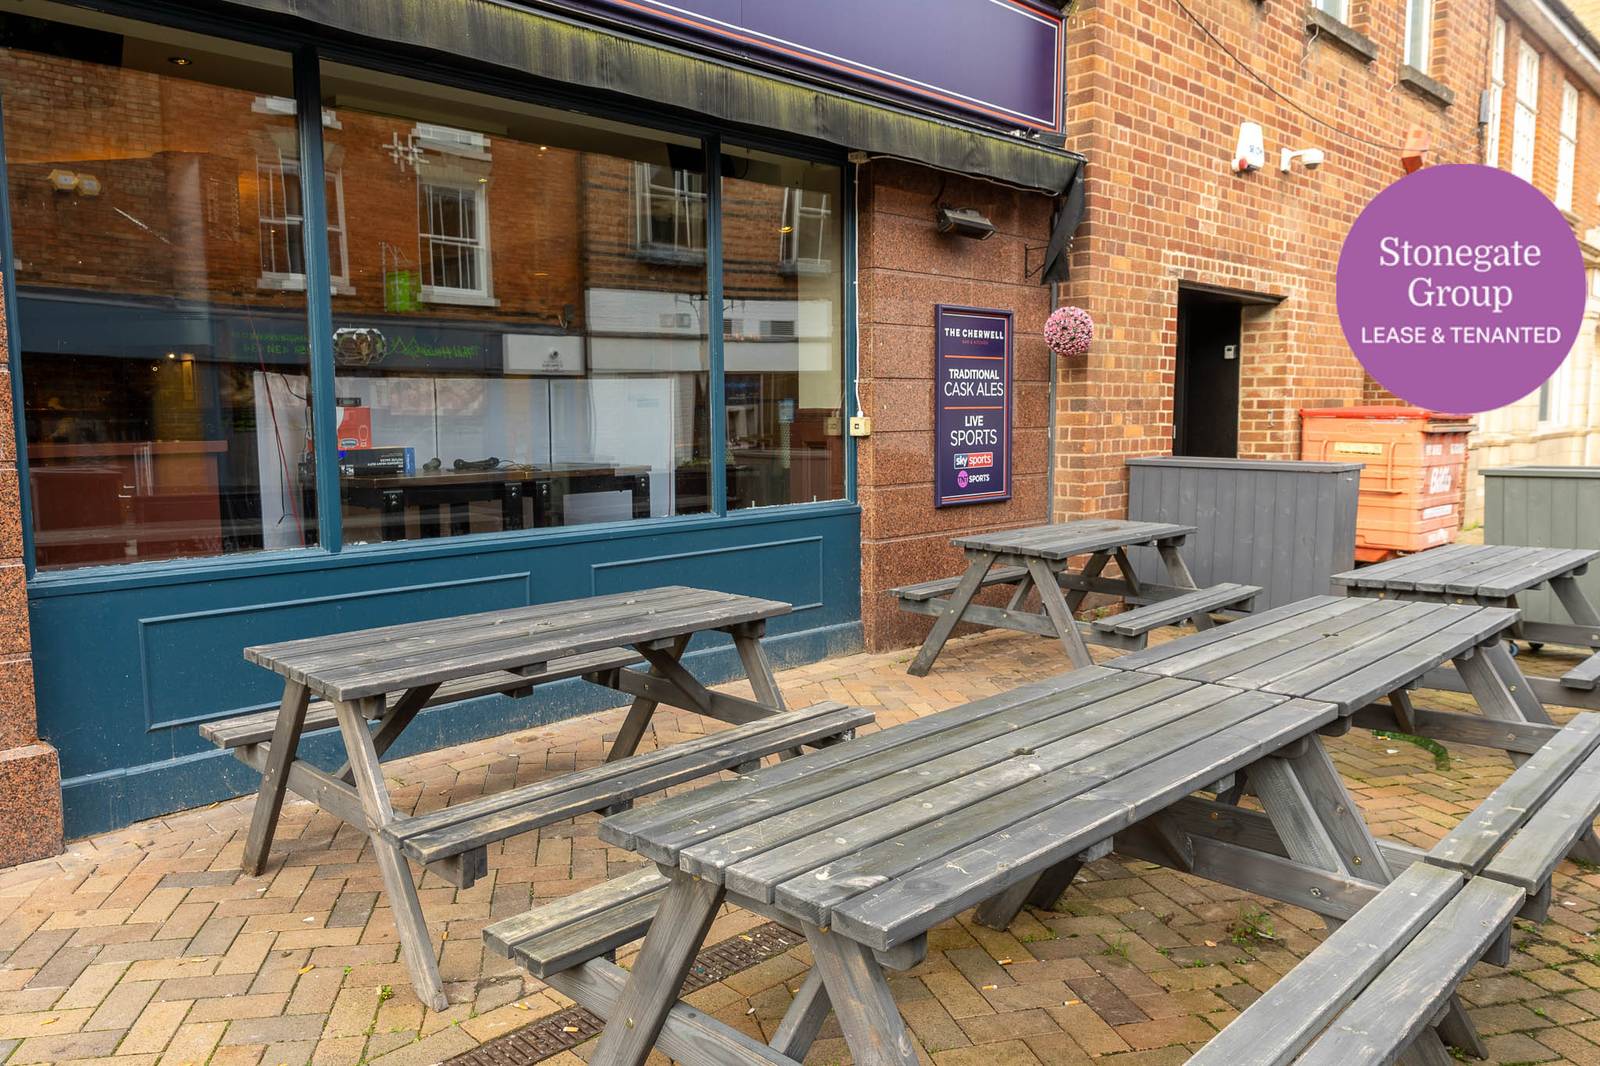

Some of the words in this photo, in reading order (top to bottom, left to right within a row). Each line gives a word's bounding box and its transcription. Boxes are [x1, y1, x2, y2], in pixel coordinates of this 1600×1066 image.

[944, 328, 960, 337] THE
[962, 329, 1004, 339] CHERWELL
[949, 368, 999, 379] TRADITIONAL
[944, 381, 974, 397] CASK
[976, 382, 1004, 397] ALES
[965, 415, 984, 427] LIVE
[950, 429, 997, 446] SPORTS
[956, 455, 967, 467] sky
[968, 455, 991, 466] sports
[969, 474, 989, 482] SPORTS
